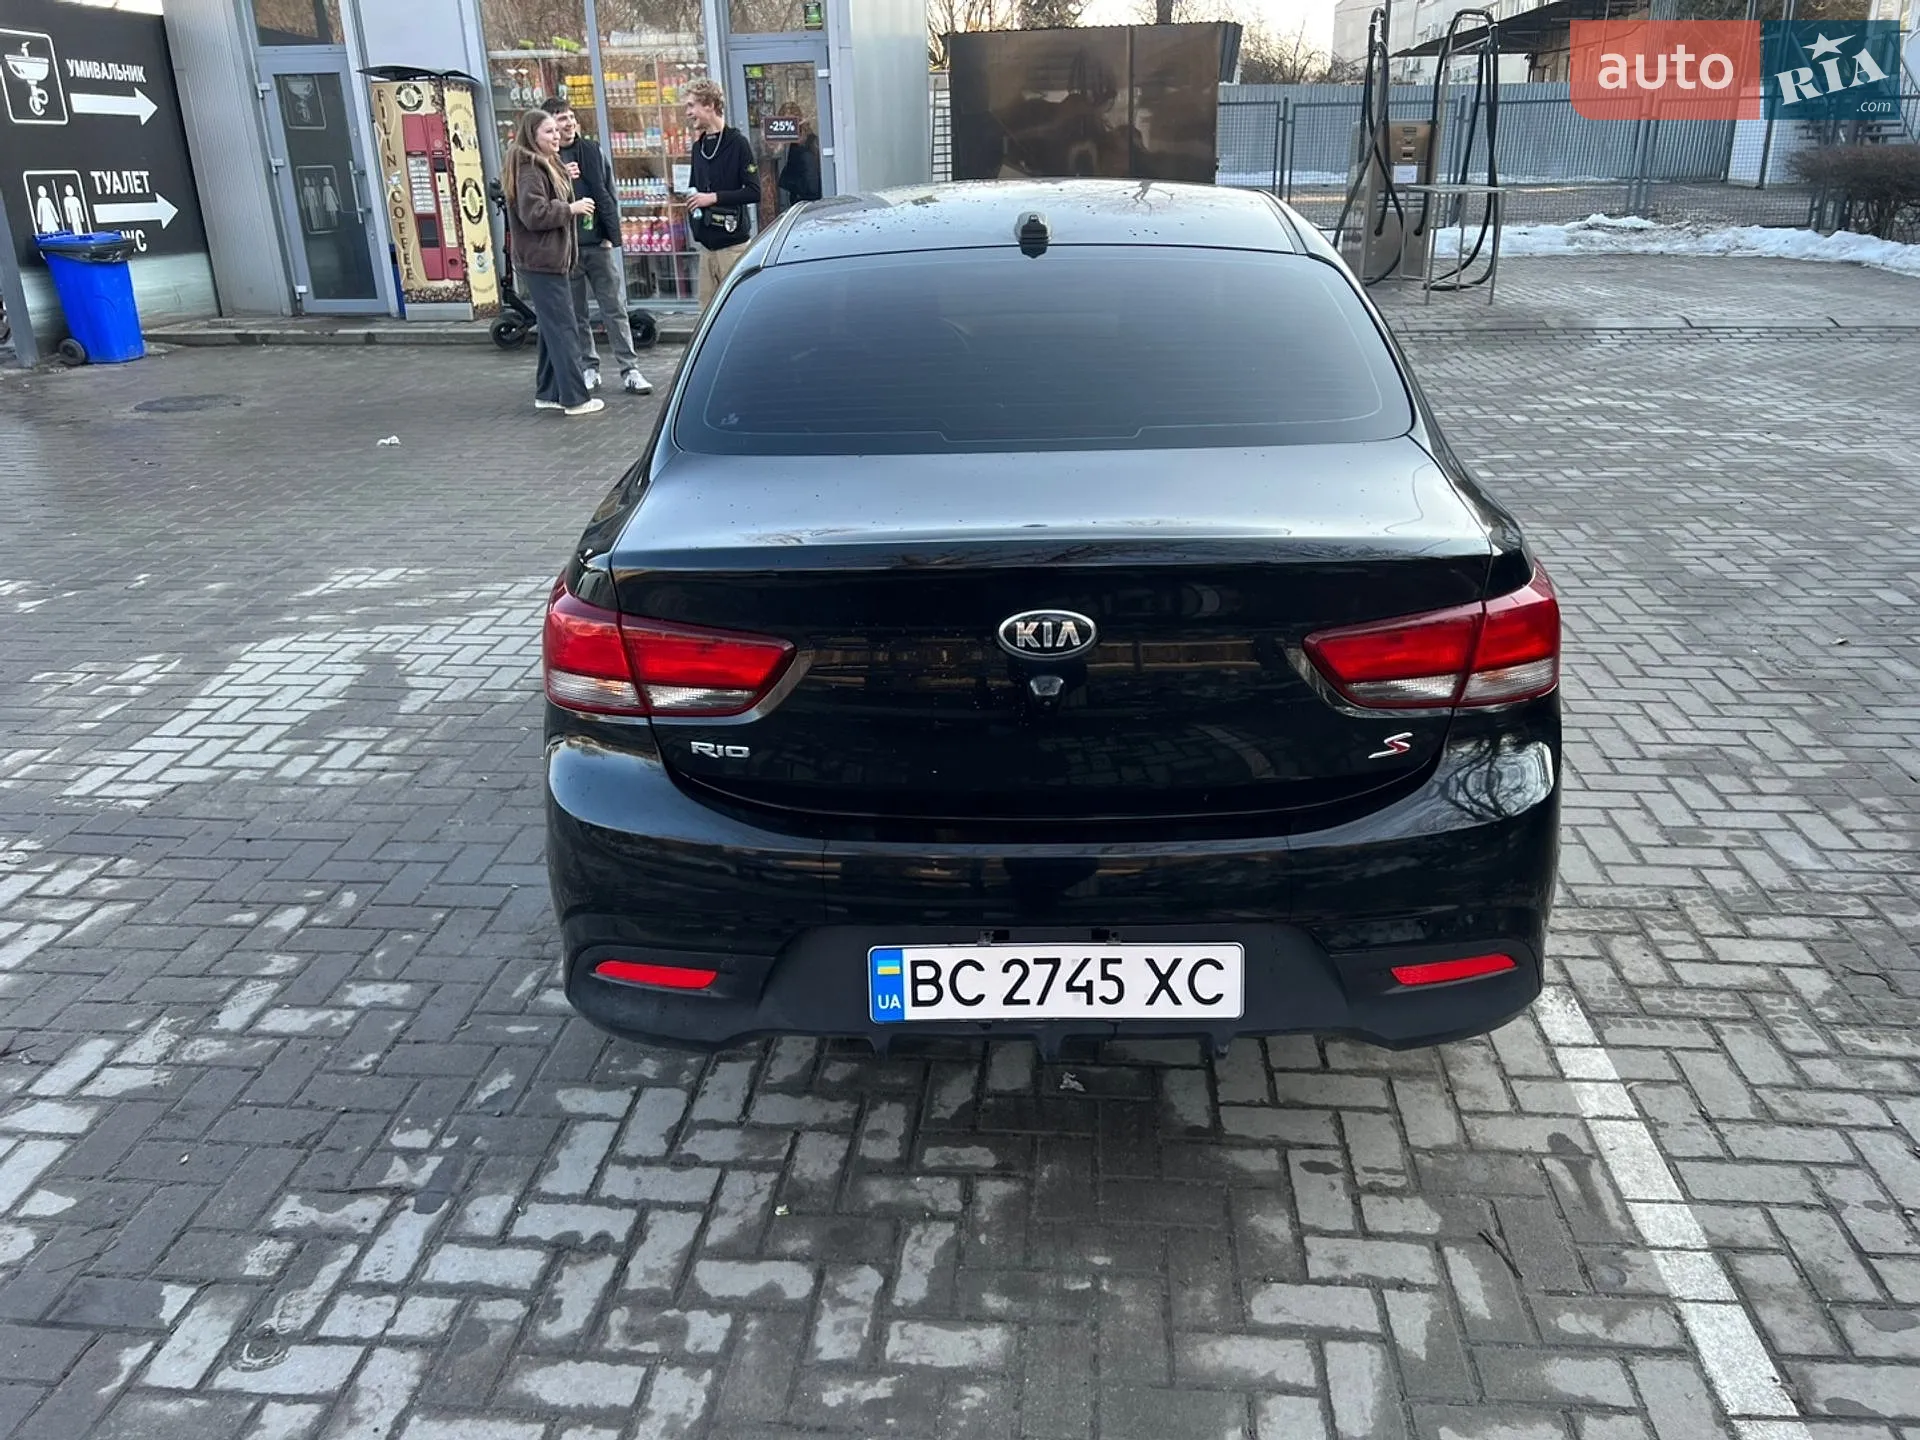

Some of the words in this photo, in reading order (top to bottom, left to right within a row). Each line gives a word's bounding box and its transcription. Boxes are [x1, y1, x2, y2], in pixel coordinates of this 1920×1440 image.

[66, 58, 147, 84] УМИВАЛЬНИК
[769, 120, 796, 132] -25%
[90, 170, 151, 195] ТУАЛЕТ
[377, 88, 397, 168] FILIN
[391, 190, 414, 280] COFFEE
[1015, 620, 1081, 648] KIA
[690, 741, 751, 759] RIO
[1368, 732, 1414, 760] S
[910, 959, 985, 1007] BC
[1001, 957, 1125, 1006] 2745
[1144, 957, 1225, 1006] XC
[878, 994, 901, 1009] UA
